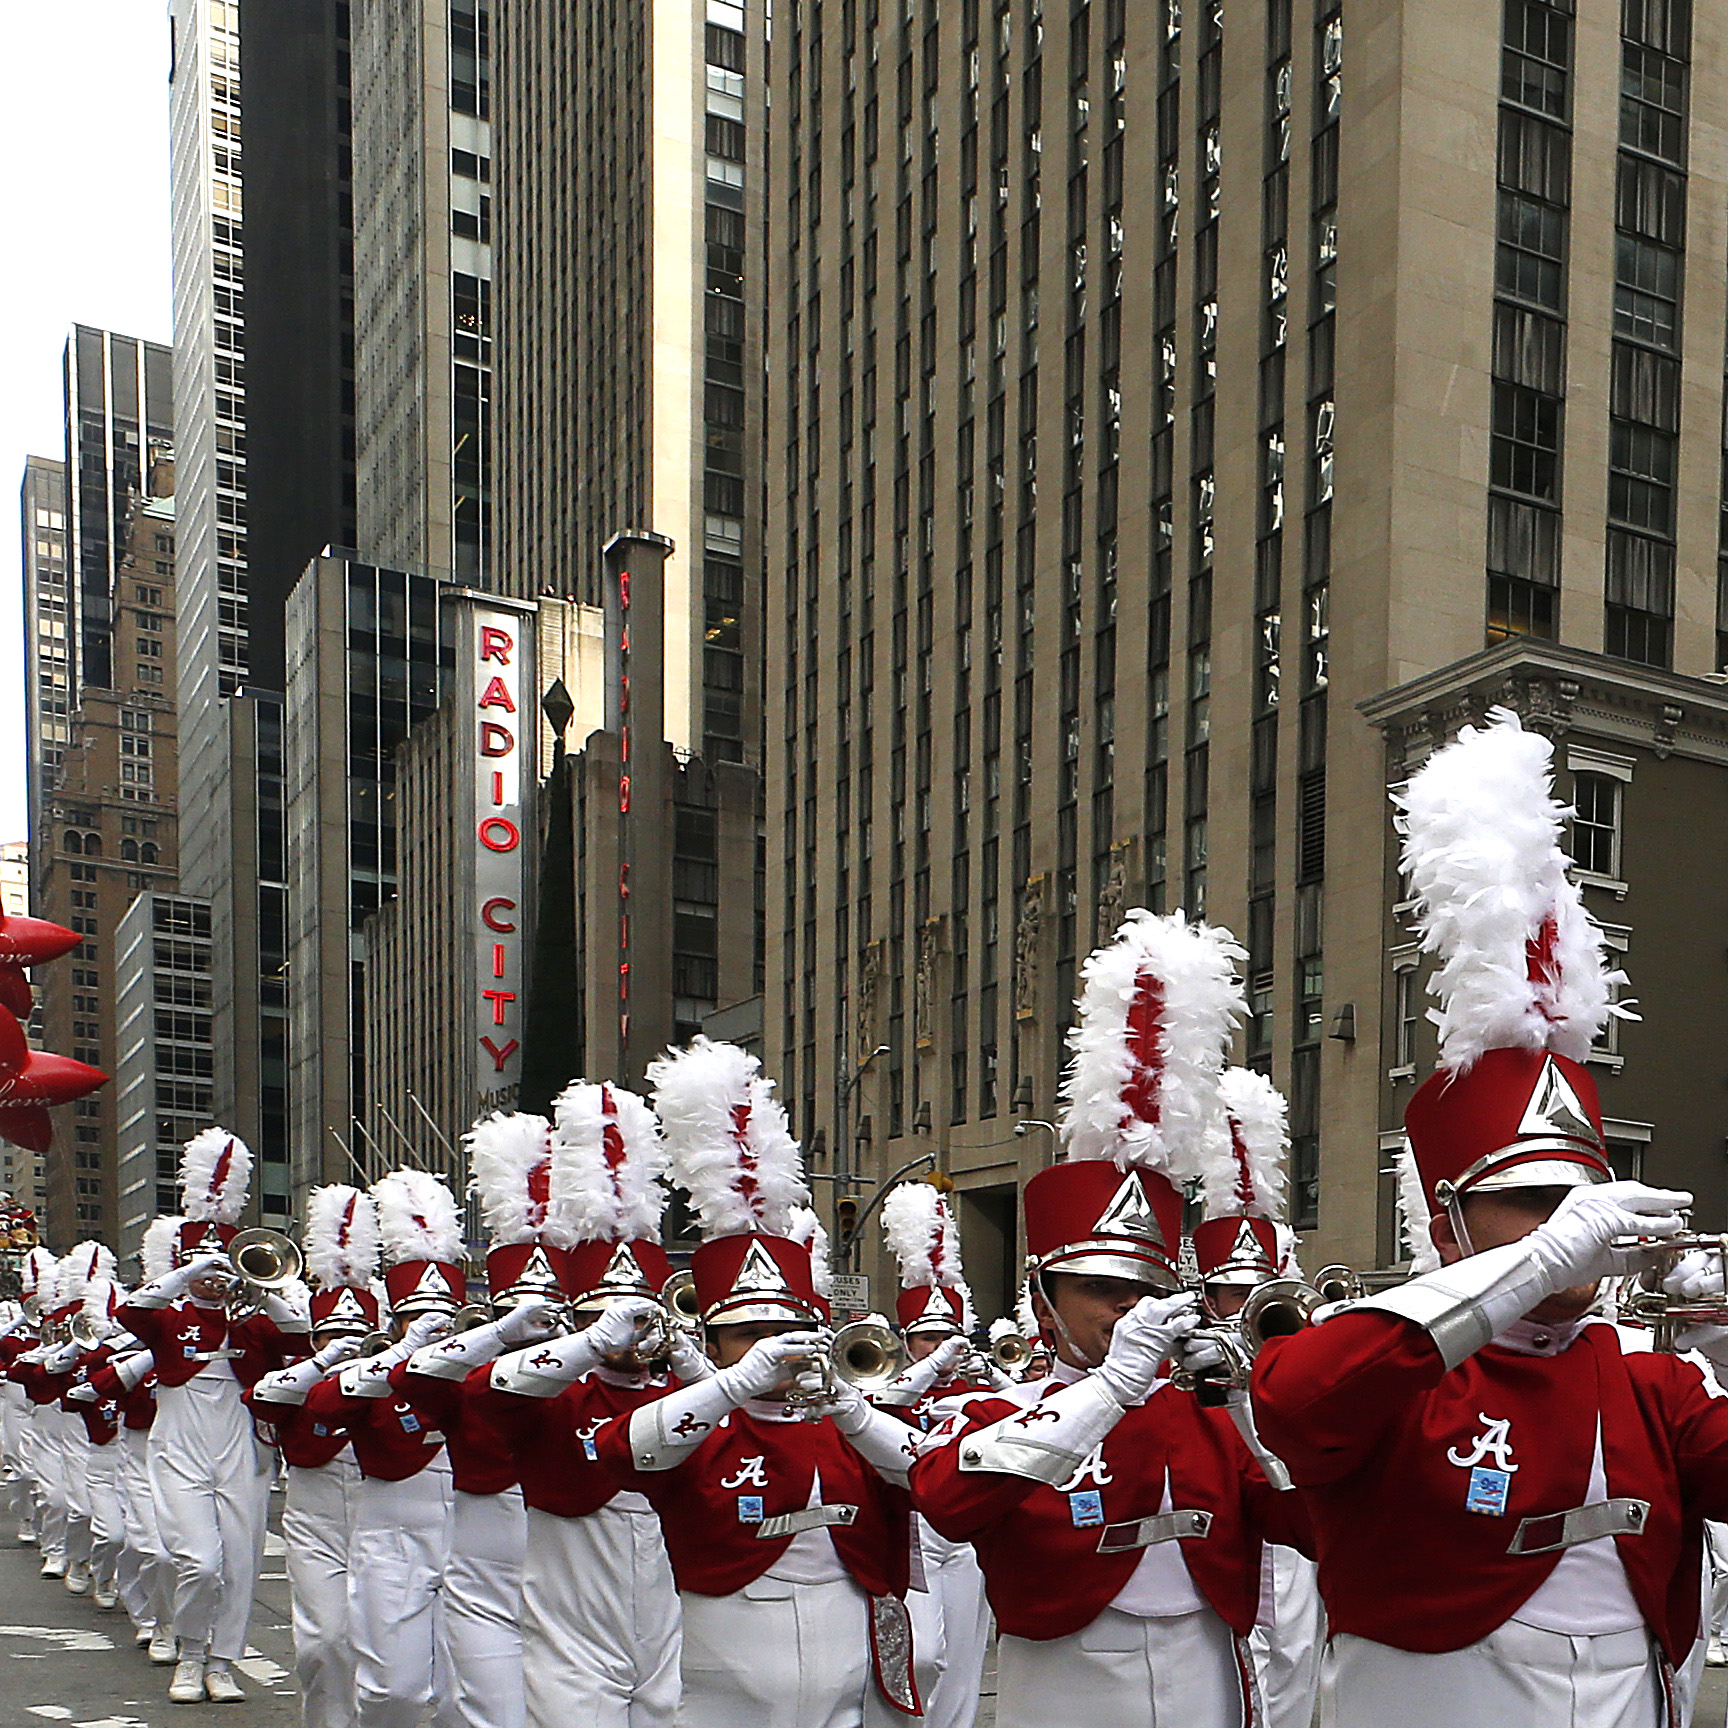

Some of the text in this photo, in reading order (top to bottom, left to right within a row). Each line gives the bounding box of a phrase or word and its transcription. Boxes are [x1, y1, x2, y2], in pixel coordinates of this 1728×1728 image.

[477, 626, 519, 1072] RADIO CITY
[834, 1288, 857, 1297] ONLY
